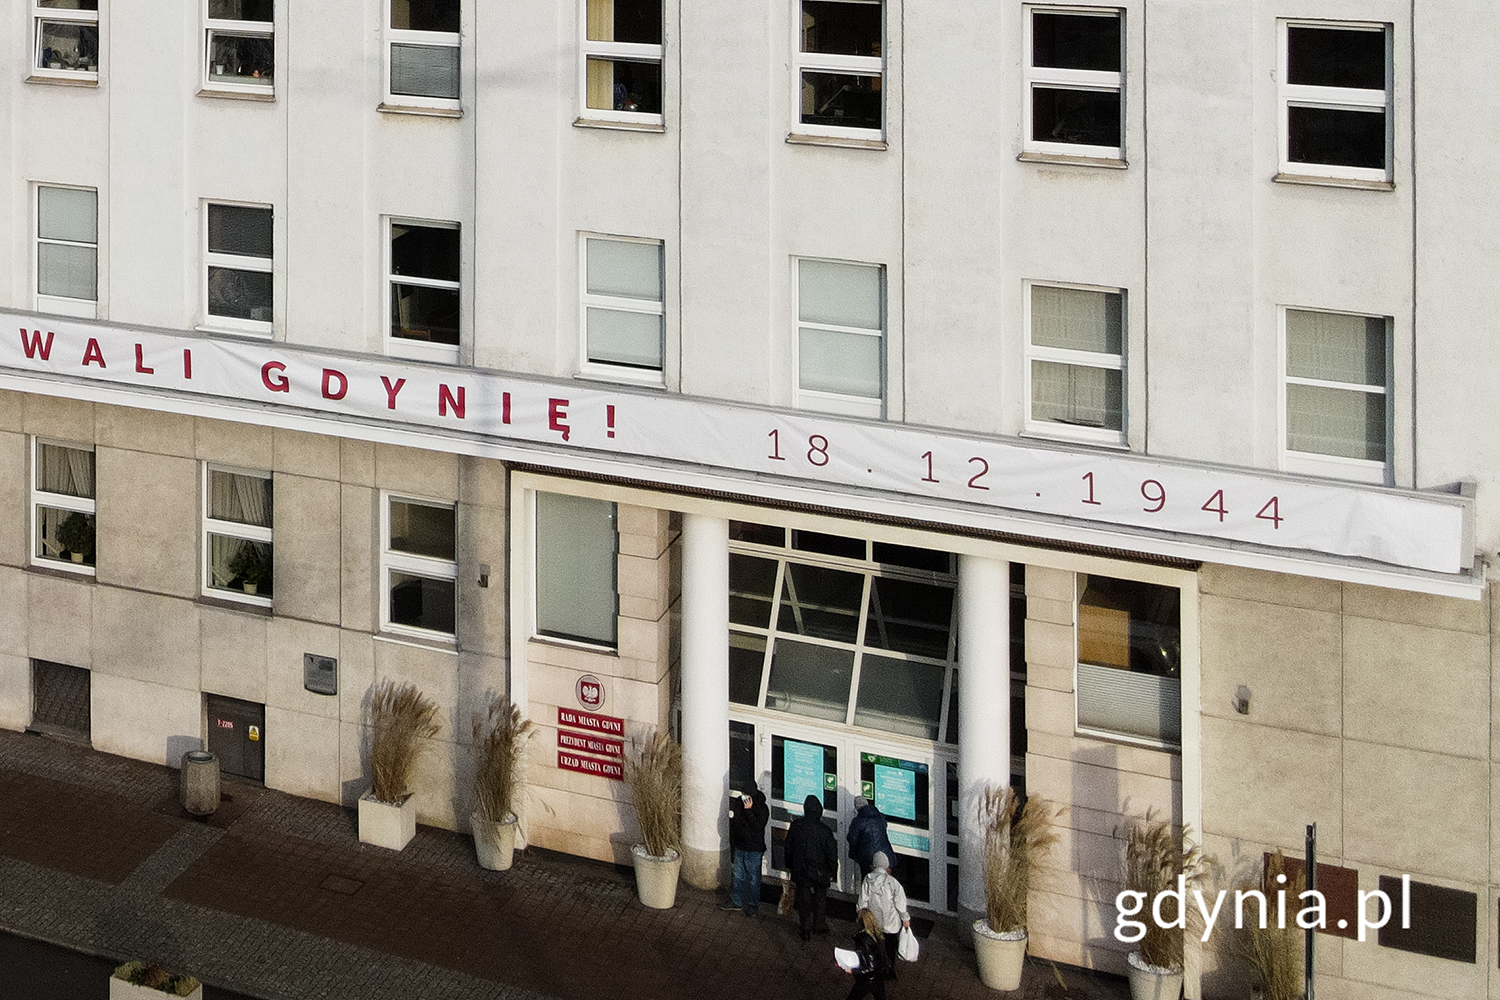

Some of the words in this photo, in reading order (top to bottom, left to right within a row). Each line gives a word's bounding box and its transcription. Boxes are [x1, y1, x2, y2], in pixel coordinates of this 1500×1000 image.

[260, 360, 616, 442] GDYNIĘ!
[560, 712, 577, 724] RADA
[578, 715, 600, 728] MIASTA
[601, 719, 621, 732] GDYNI
[560, 735, 587, 748] PREZYDENT
[587, 740, 605, 752] MIASTA
[605, 743, 621, 755] GDYNI
[580, 759, 602, 773] MIASTA
[602, 764, 621, 776] GDYNI
